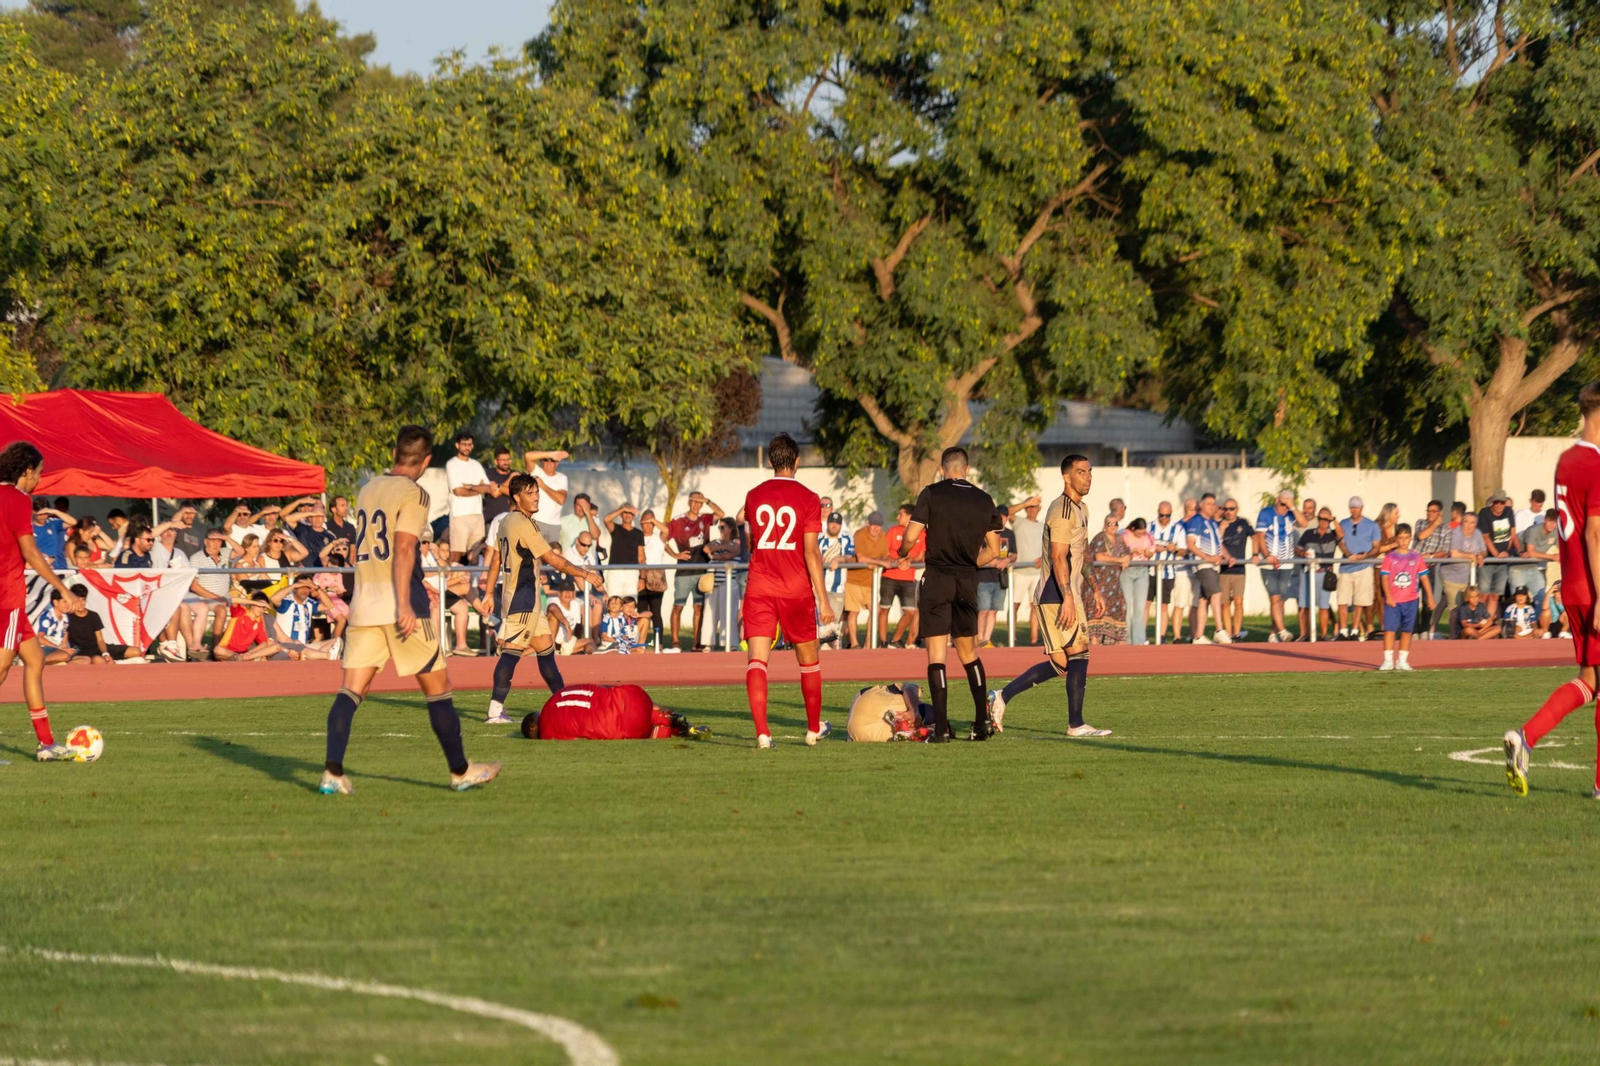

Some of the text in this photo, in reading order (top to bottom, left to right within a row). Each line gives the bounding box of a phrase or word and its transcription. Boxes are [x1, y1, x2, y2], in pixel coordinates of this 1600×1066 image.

[356, 508, 390, 562] 23
[756, 504, 797, 551] 22
[556, 689, 594, 710] 11
